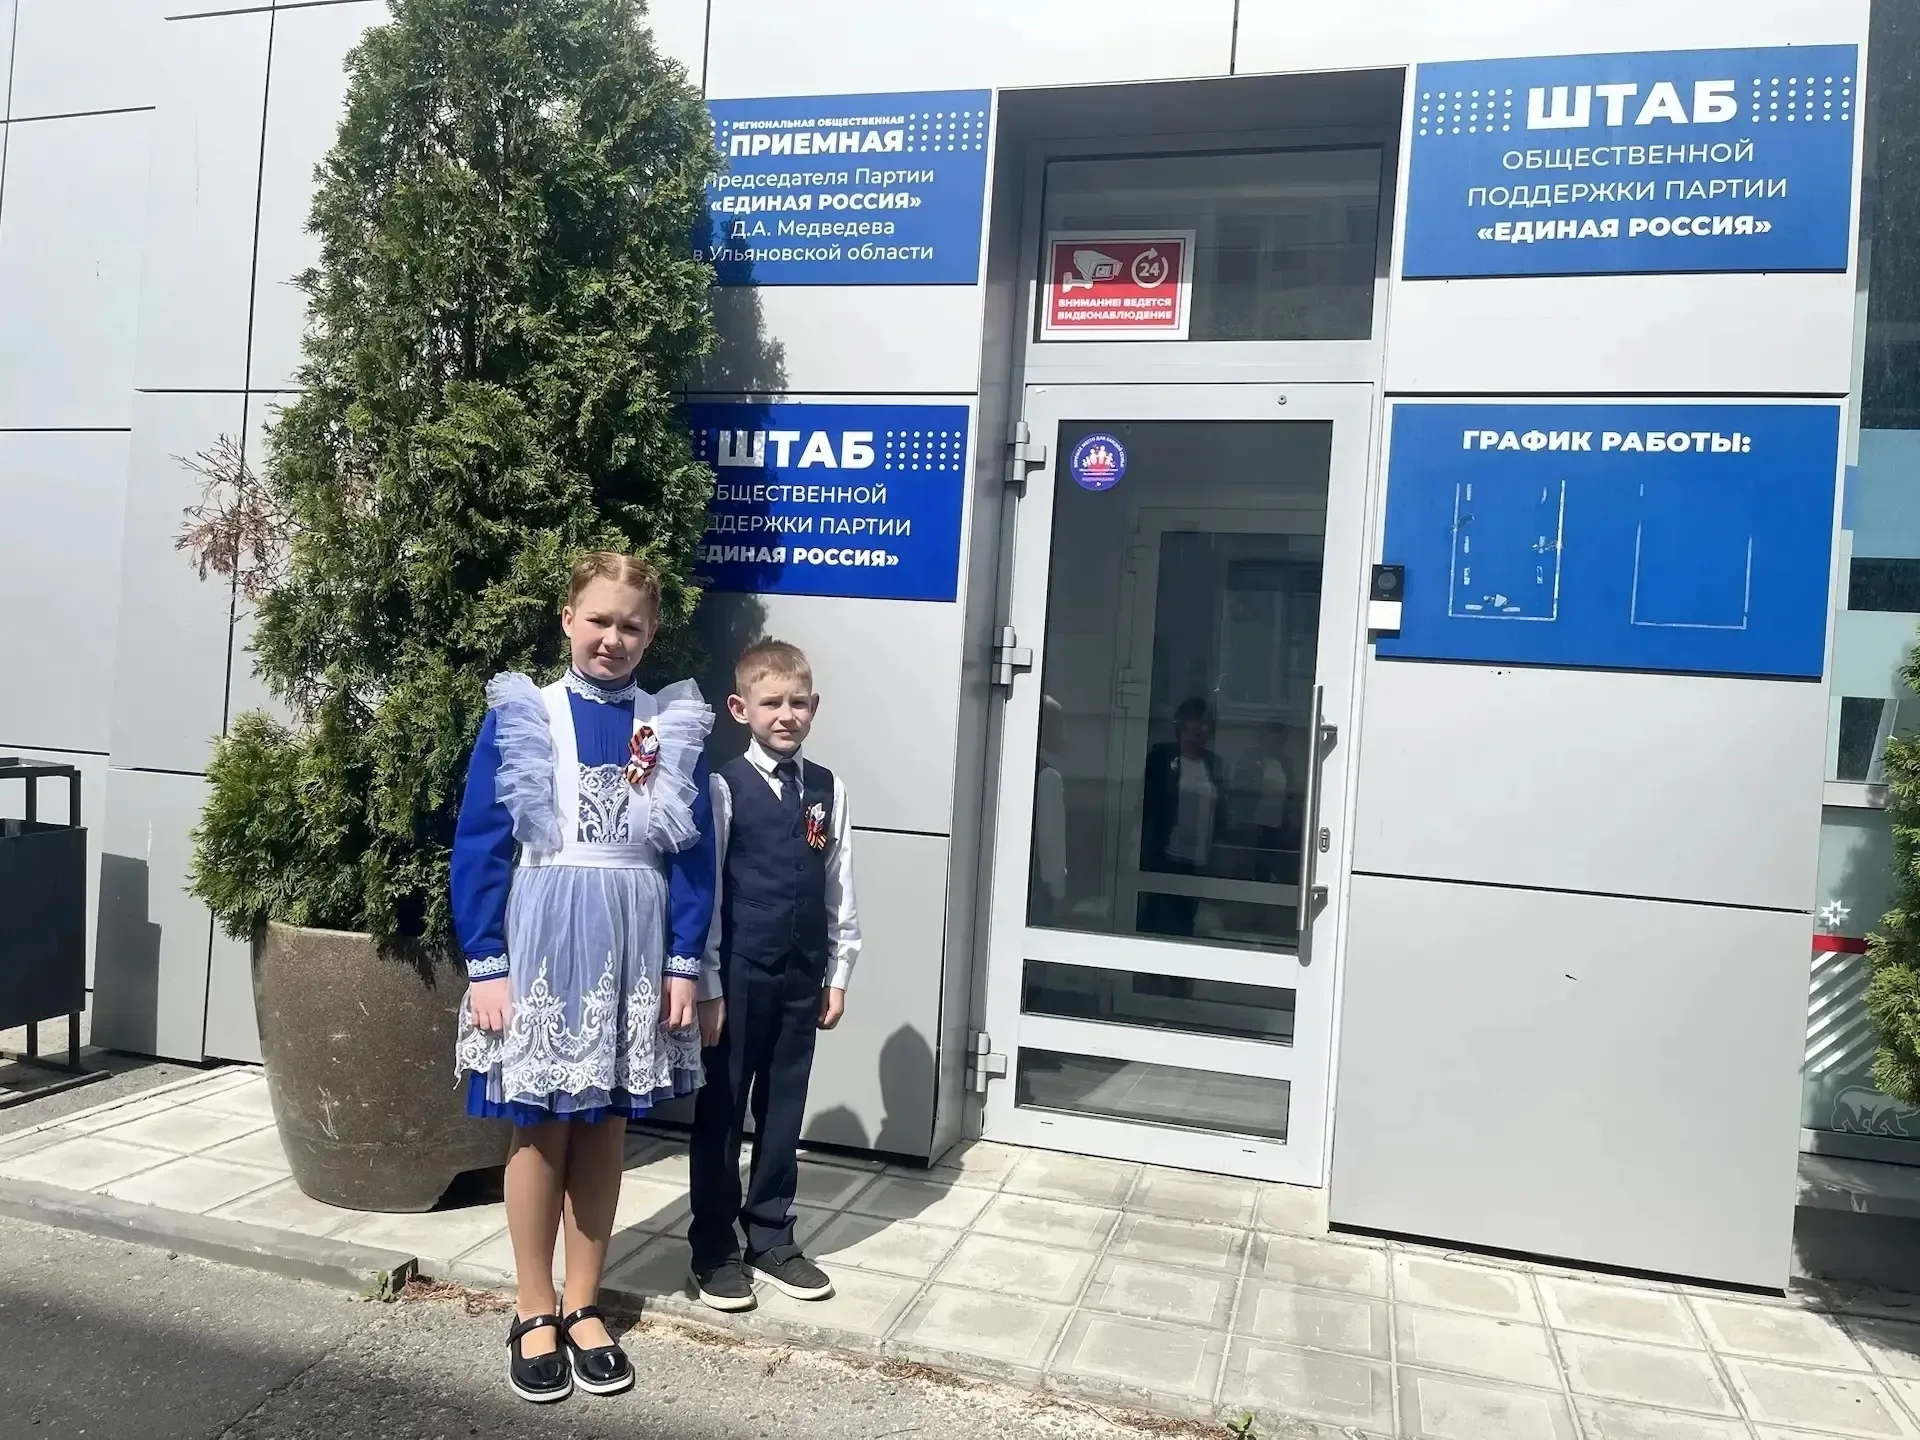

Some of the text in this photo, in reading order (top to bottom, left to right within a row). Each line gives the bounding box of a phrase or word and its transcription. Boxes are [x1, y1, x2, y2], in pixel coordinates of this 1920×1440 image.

[1526, 80, 1738, 130] ШТАБ
[732, 116, 905, 130] РЕГИОНАЛЬНАЯ ОБЩЕСТВЕННАЯ
[730, 130, 904, 157] ПРИЕМНАЯ
[1502, 139, 1755, 170] ОБЩЕСТВЕННОЙ
[855, 168, 935, 188] Партии
[1467, 178, 1788, 208] ПОДДЕРЖКИ ПАРТИИ
[711, 192, 922, 215] «ЕДИНАЯ РОССИЯ»
[731, 220, 895, 240] Д.А. Медведева
[1476, 215, 1773, 244] «ЕДИНАЯ РОССИЯ»
[693, 243, 934, 262] в Ульяновской области
[1138, 262, 1160, 277] 24
[1123, 298, 1171, 307] ВЕДЕТСЯ
[1057, 310, 1172, 321] ВИДЕОНАБЛЮДЕНИЕ
[717, 430, 875, 469] ШТАБ
[1462, 430, 1751, 453] ГРАФИК РАБОТЫ:
[820, 517, 911, 536] ПАРТИИ
[793, 547, 900, 567] РОССИЯ»
